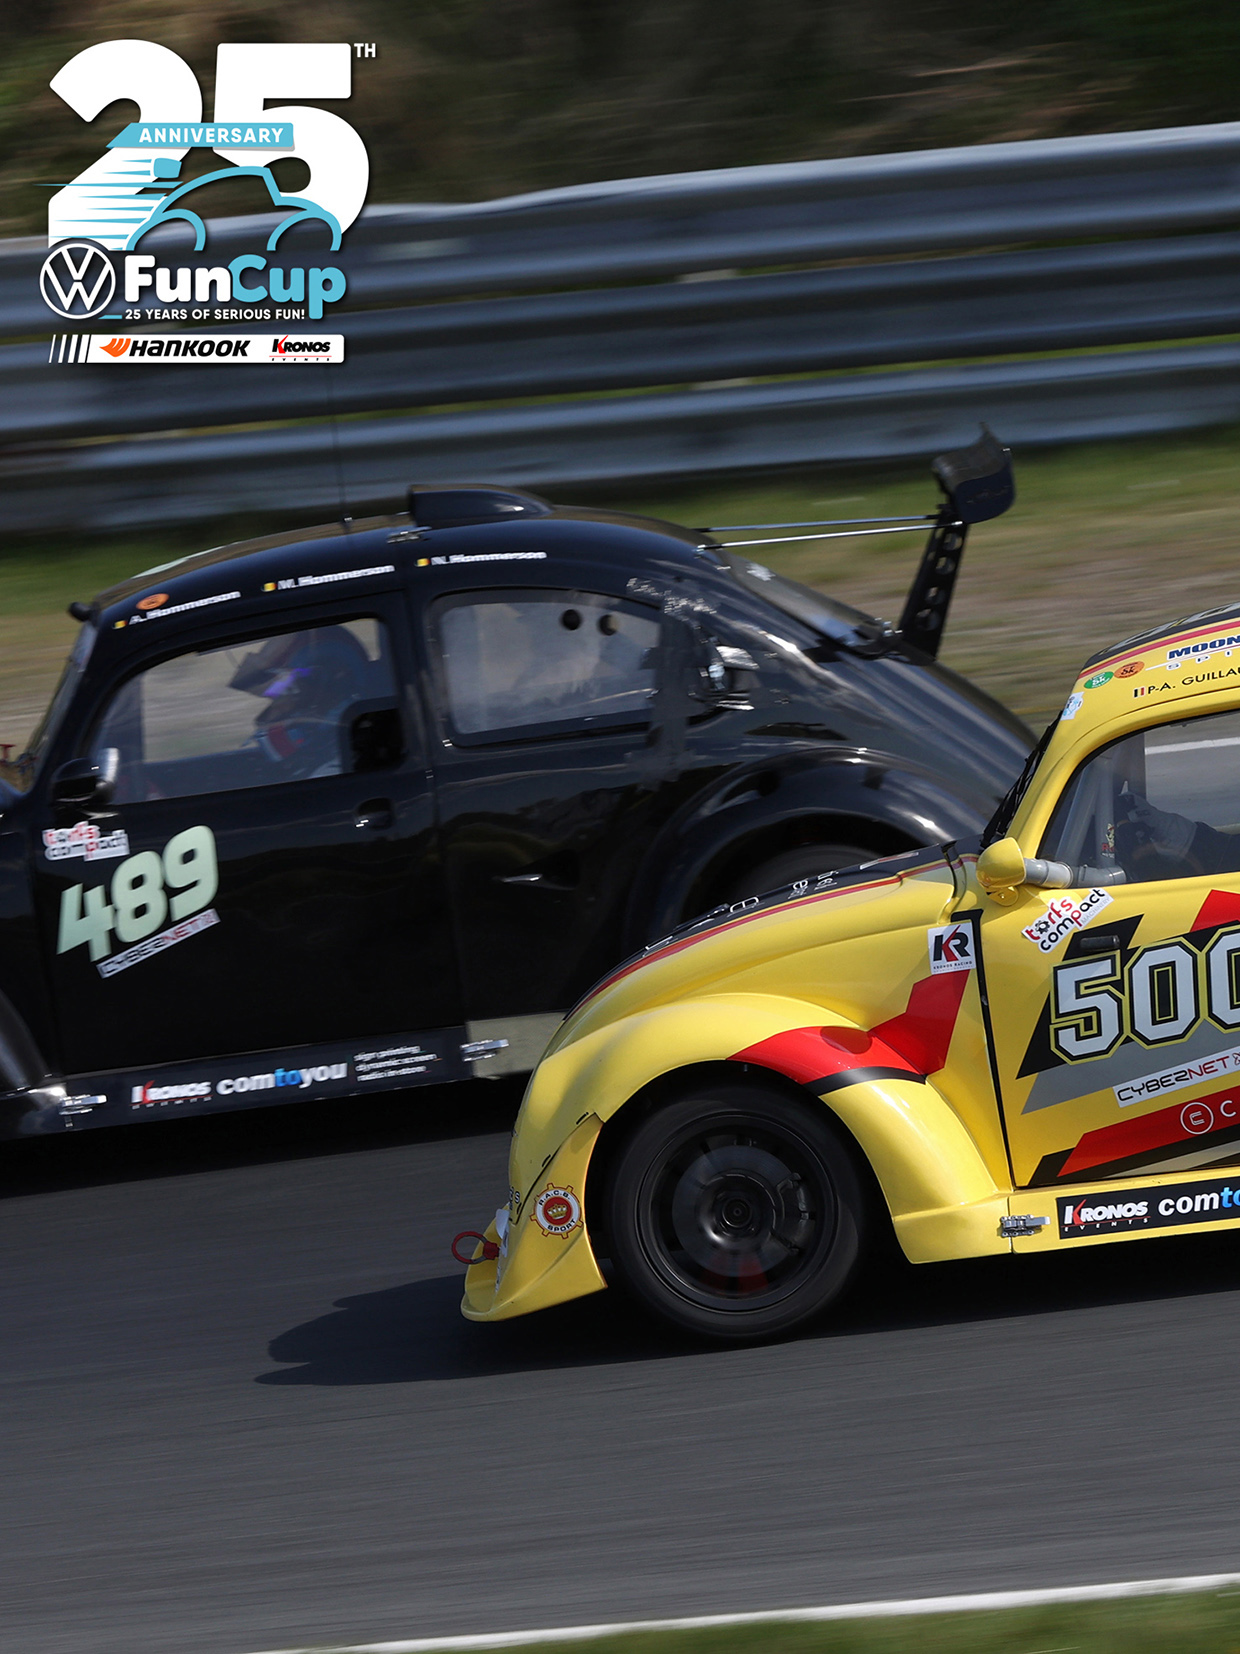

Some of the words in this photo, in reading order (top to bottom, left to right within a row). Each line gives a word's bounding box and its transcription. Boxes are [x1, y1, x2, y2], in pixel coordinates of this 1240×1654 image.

[1148, 682, 1176, 695] P-A.
[56, 825, 219, 962] 489
[1040, 889, 1105, 951] compact
[933, 925, 971, 962] KR
[216, 1062, 348, 1096] comtoyou
[1064, 1199, 1148, 1225] KRONOS
[1064, 1218, 1149, 1232] EVENTS
